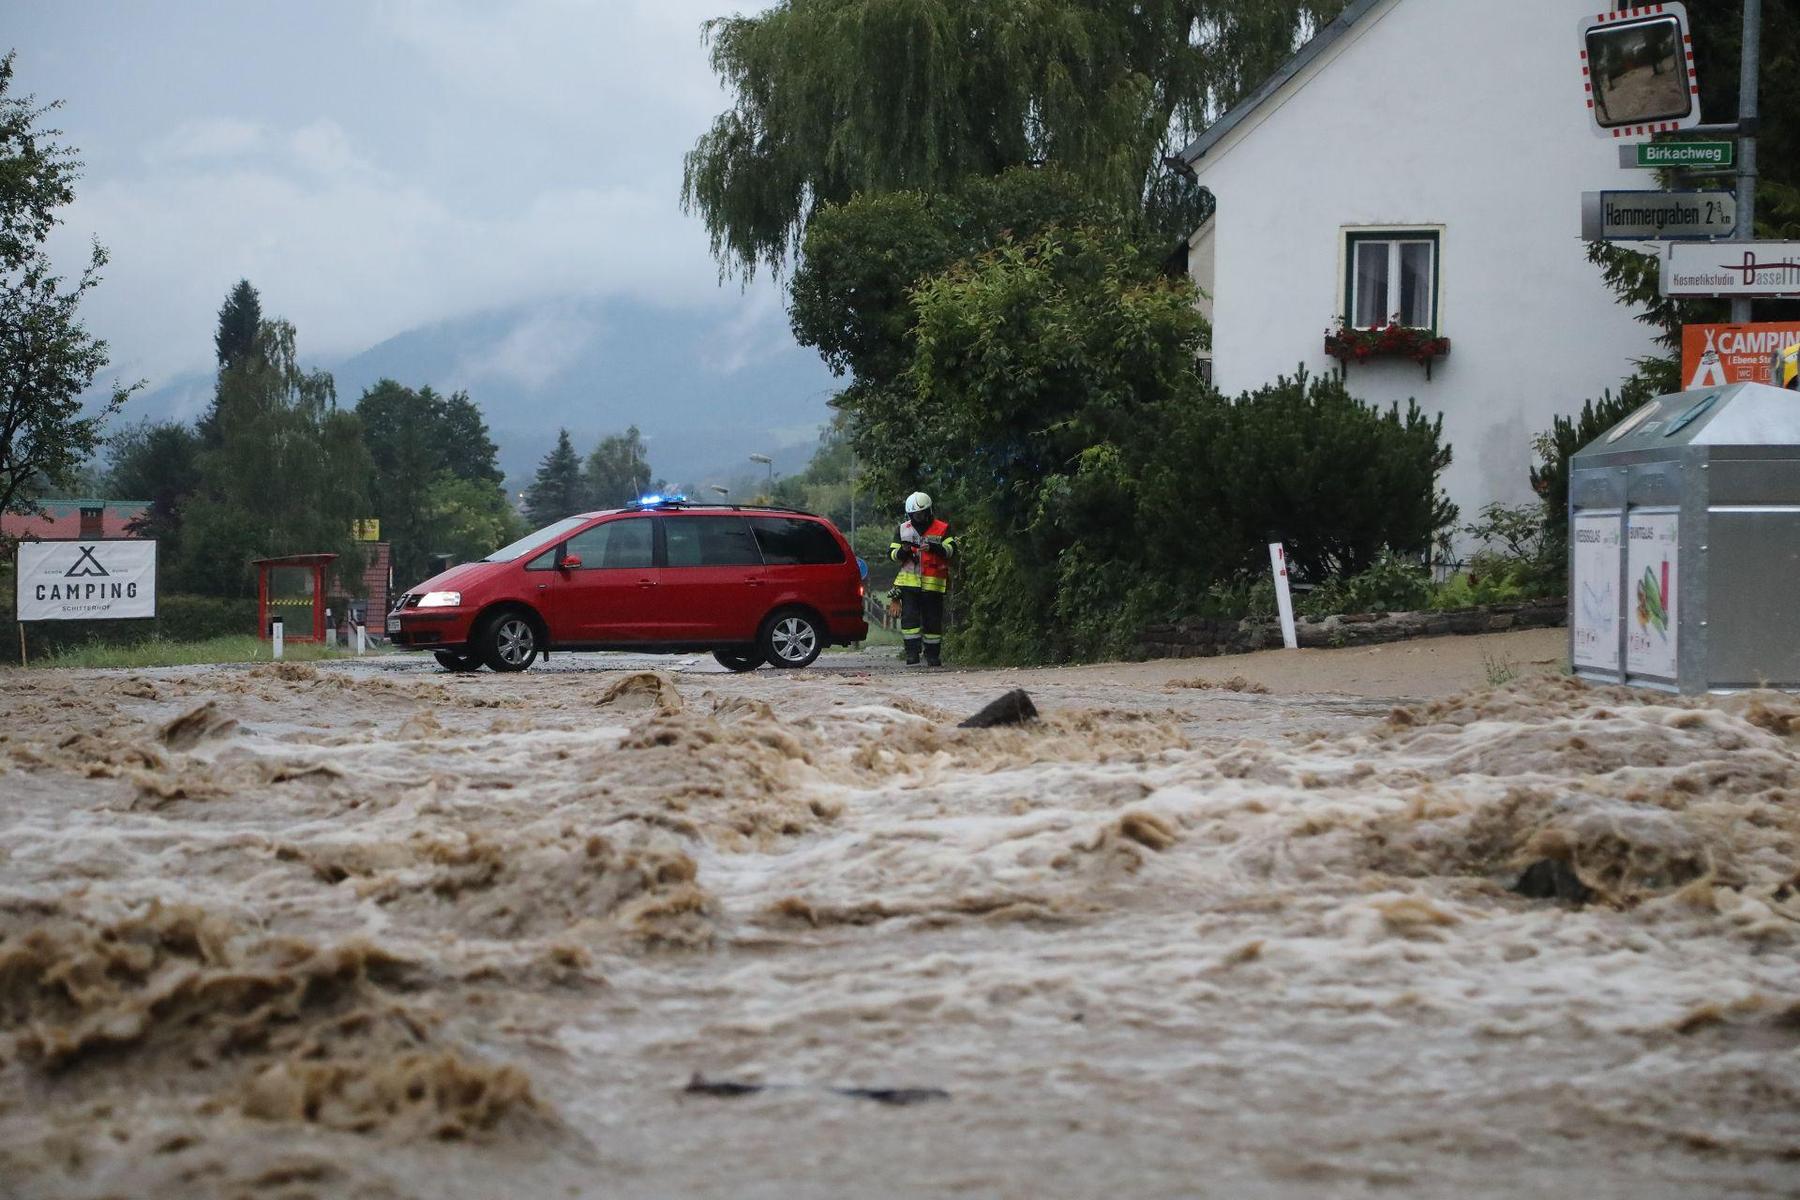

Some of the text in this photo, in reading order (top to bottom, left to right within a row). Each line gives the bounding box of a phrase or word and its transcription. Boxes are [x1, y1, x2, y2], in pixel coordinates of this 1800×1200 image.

[1646, 147, 1722, 161] Birkachweg
[1606, 202, 1699, 229] Hammergraben
[1673, 273, 1735, 286] Kosmetikstudio
[36, 582, 137, 601] CAMPING
